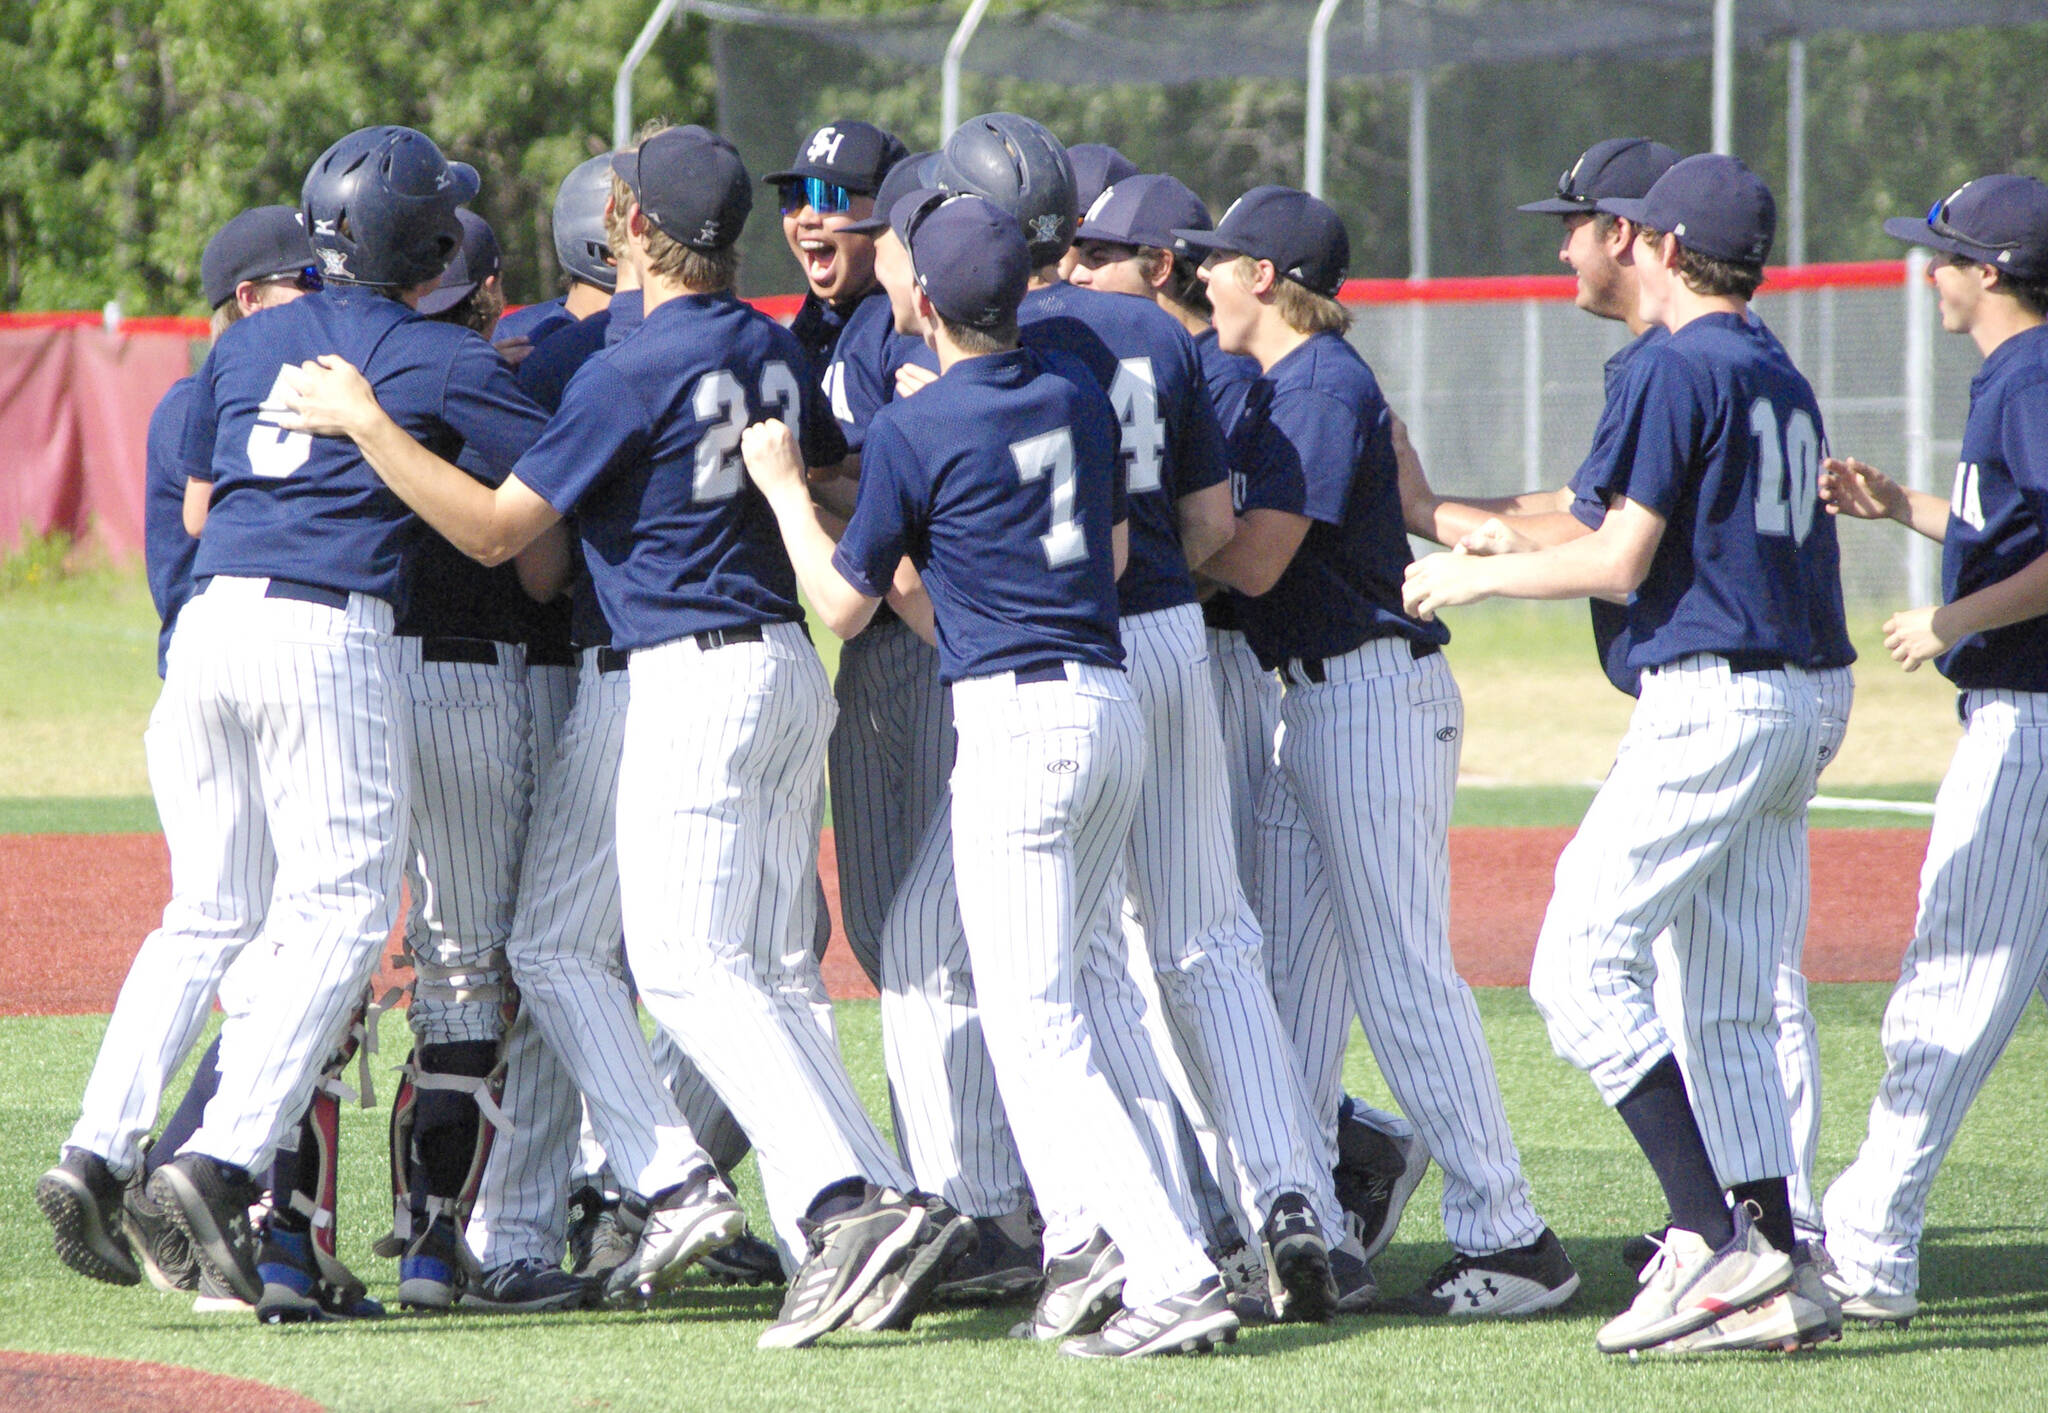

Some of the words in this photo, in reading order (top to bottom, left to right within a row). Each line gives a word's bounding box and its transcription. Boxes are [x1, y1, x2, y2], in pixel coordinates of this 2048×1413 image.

[1107, 356, 1166, 493] 4
[1750, 396, 1819, 548] 10
[1009, 425, 1090, 570] 7
